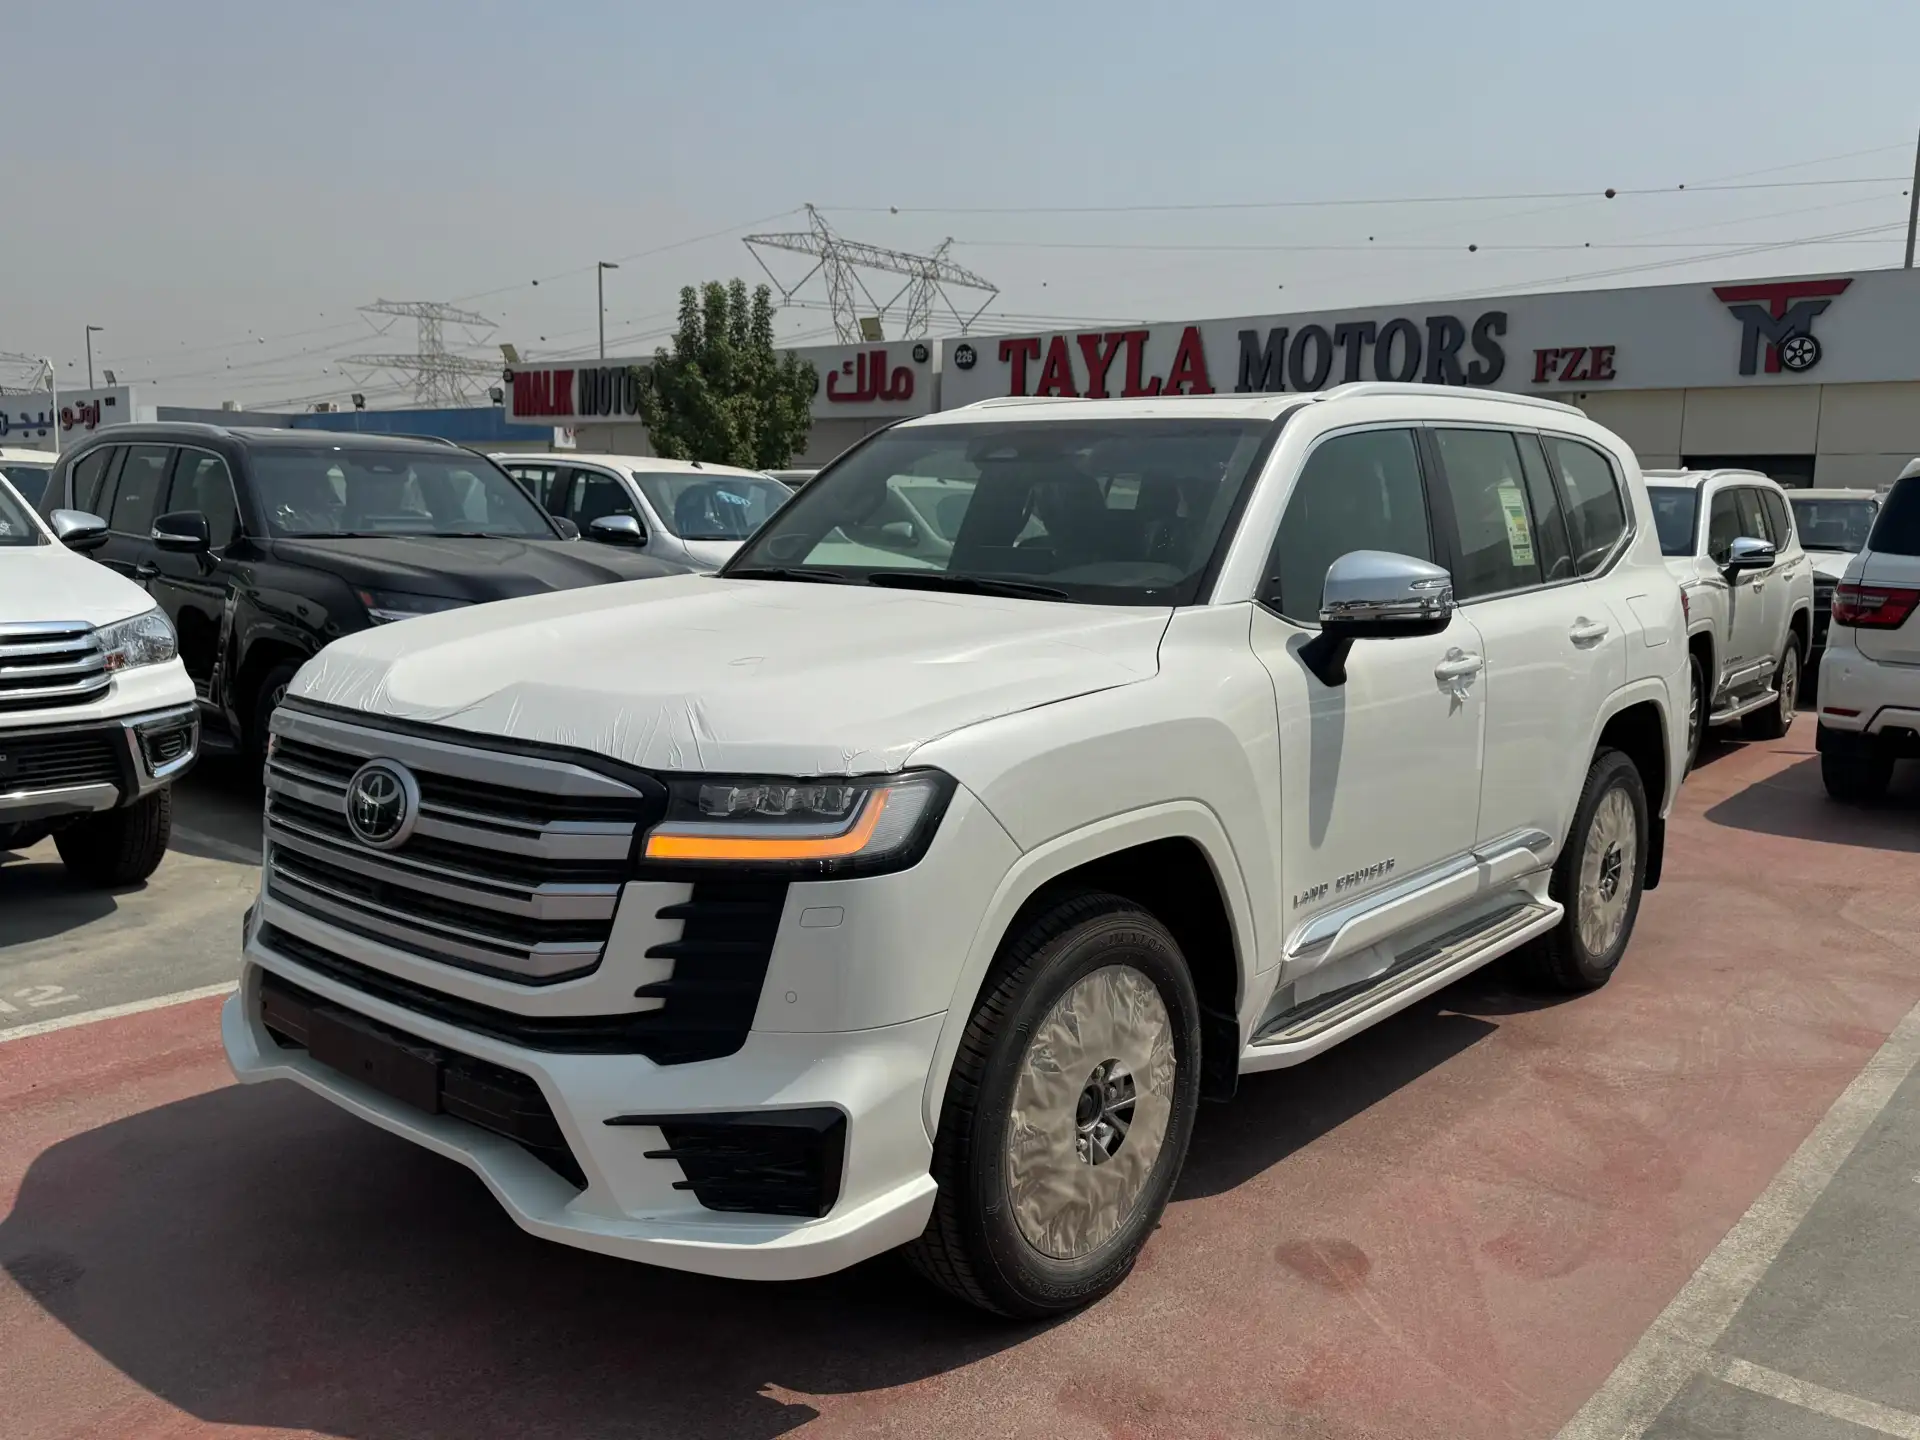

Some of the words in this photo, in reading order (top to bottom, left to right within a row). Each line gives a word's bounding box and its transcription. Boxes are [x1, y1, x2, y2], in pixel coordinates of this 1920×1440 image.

[826, 350, 914, 403] مالك
[999, 326, 1216, 399] TAYLA
[1234, 310, 1508, 394] MOTORS
[1531, 345, 1616, 383] FZE
[513, 369, 575, 417] MALIK
[1293, 882, 1328, 910] LAND
[1335, 856, 1395, 893] CRUISER
